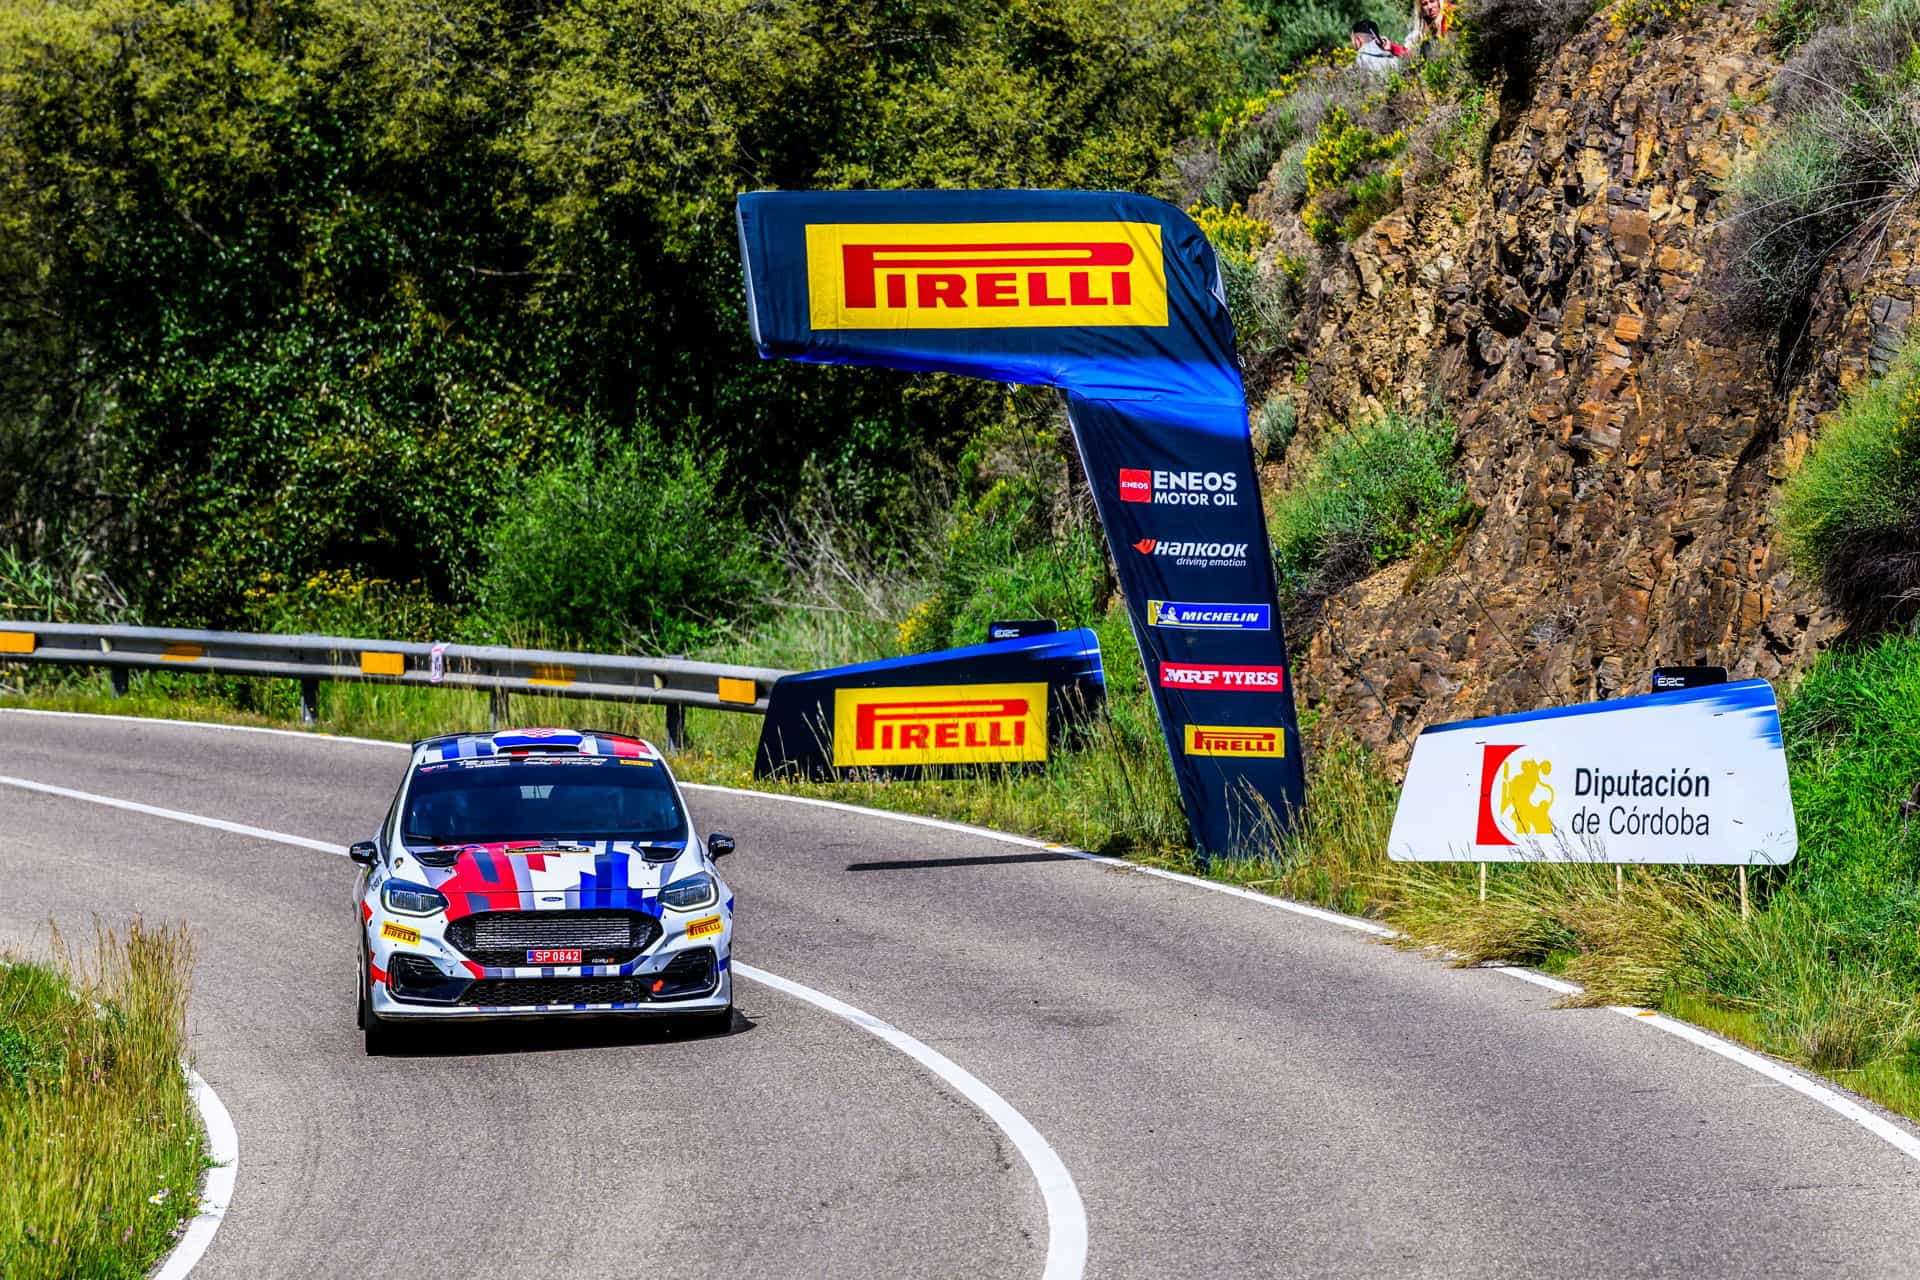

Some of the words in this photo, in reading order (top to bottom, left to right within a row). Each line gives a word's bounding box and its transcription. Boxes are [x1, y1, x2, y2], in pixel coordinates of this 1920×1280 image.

[842, 242, 1134, 309] PIRELLI
[1121, 481, 1149, 490] ENEOS
[1153, 470, 1238, 491] ENEOS
[1154, 492, 1209, 505] MOTOR
[1213, 493, 1238, 505] OIL
[1176, 558, 1208, 568] driving
[1208, 558, 1247, 567] emotion
[1181, 610, 1259, 622] MICHELIN
[1164, 668, 1219, 684] MRF
[1222, 671, 1279, 685] TYRES
[856, 699, 1029, 750] PIRELLI
[1194, 731, 1276, 752] PIRELLI
[1574, 768, 1710, 803] Diputación
[1571, 806, 1600, 835] de
[1608, 805, 1710, 835] Córdoba
[384, 924, 417, 942] PIRELLI
[689, 918, 721, 936] PIRELLI
[535, 952, 551, 962] SP
[552, 952, 579, 961] 0842
